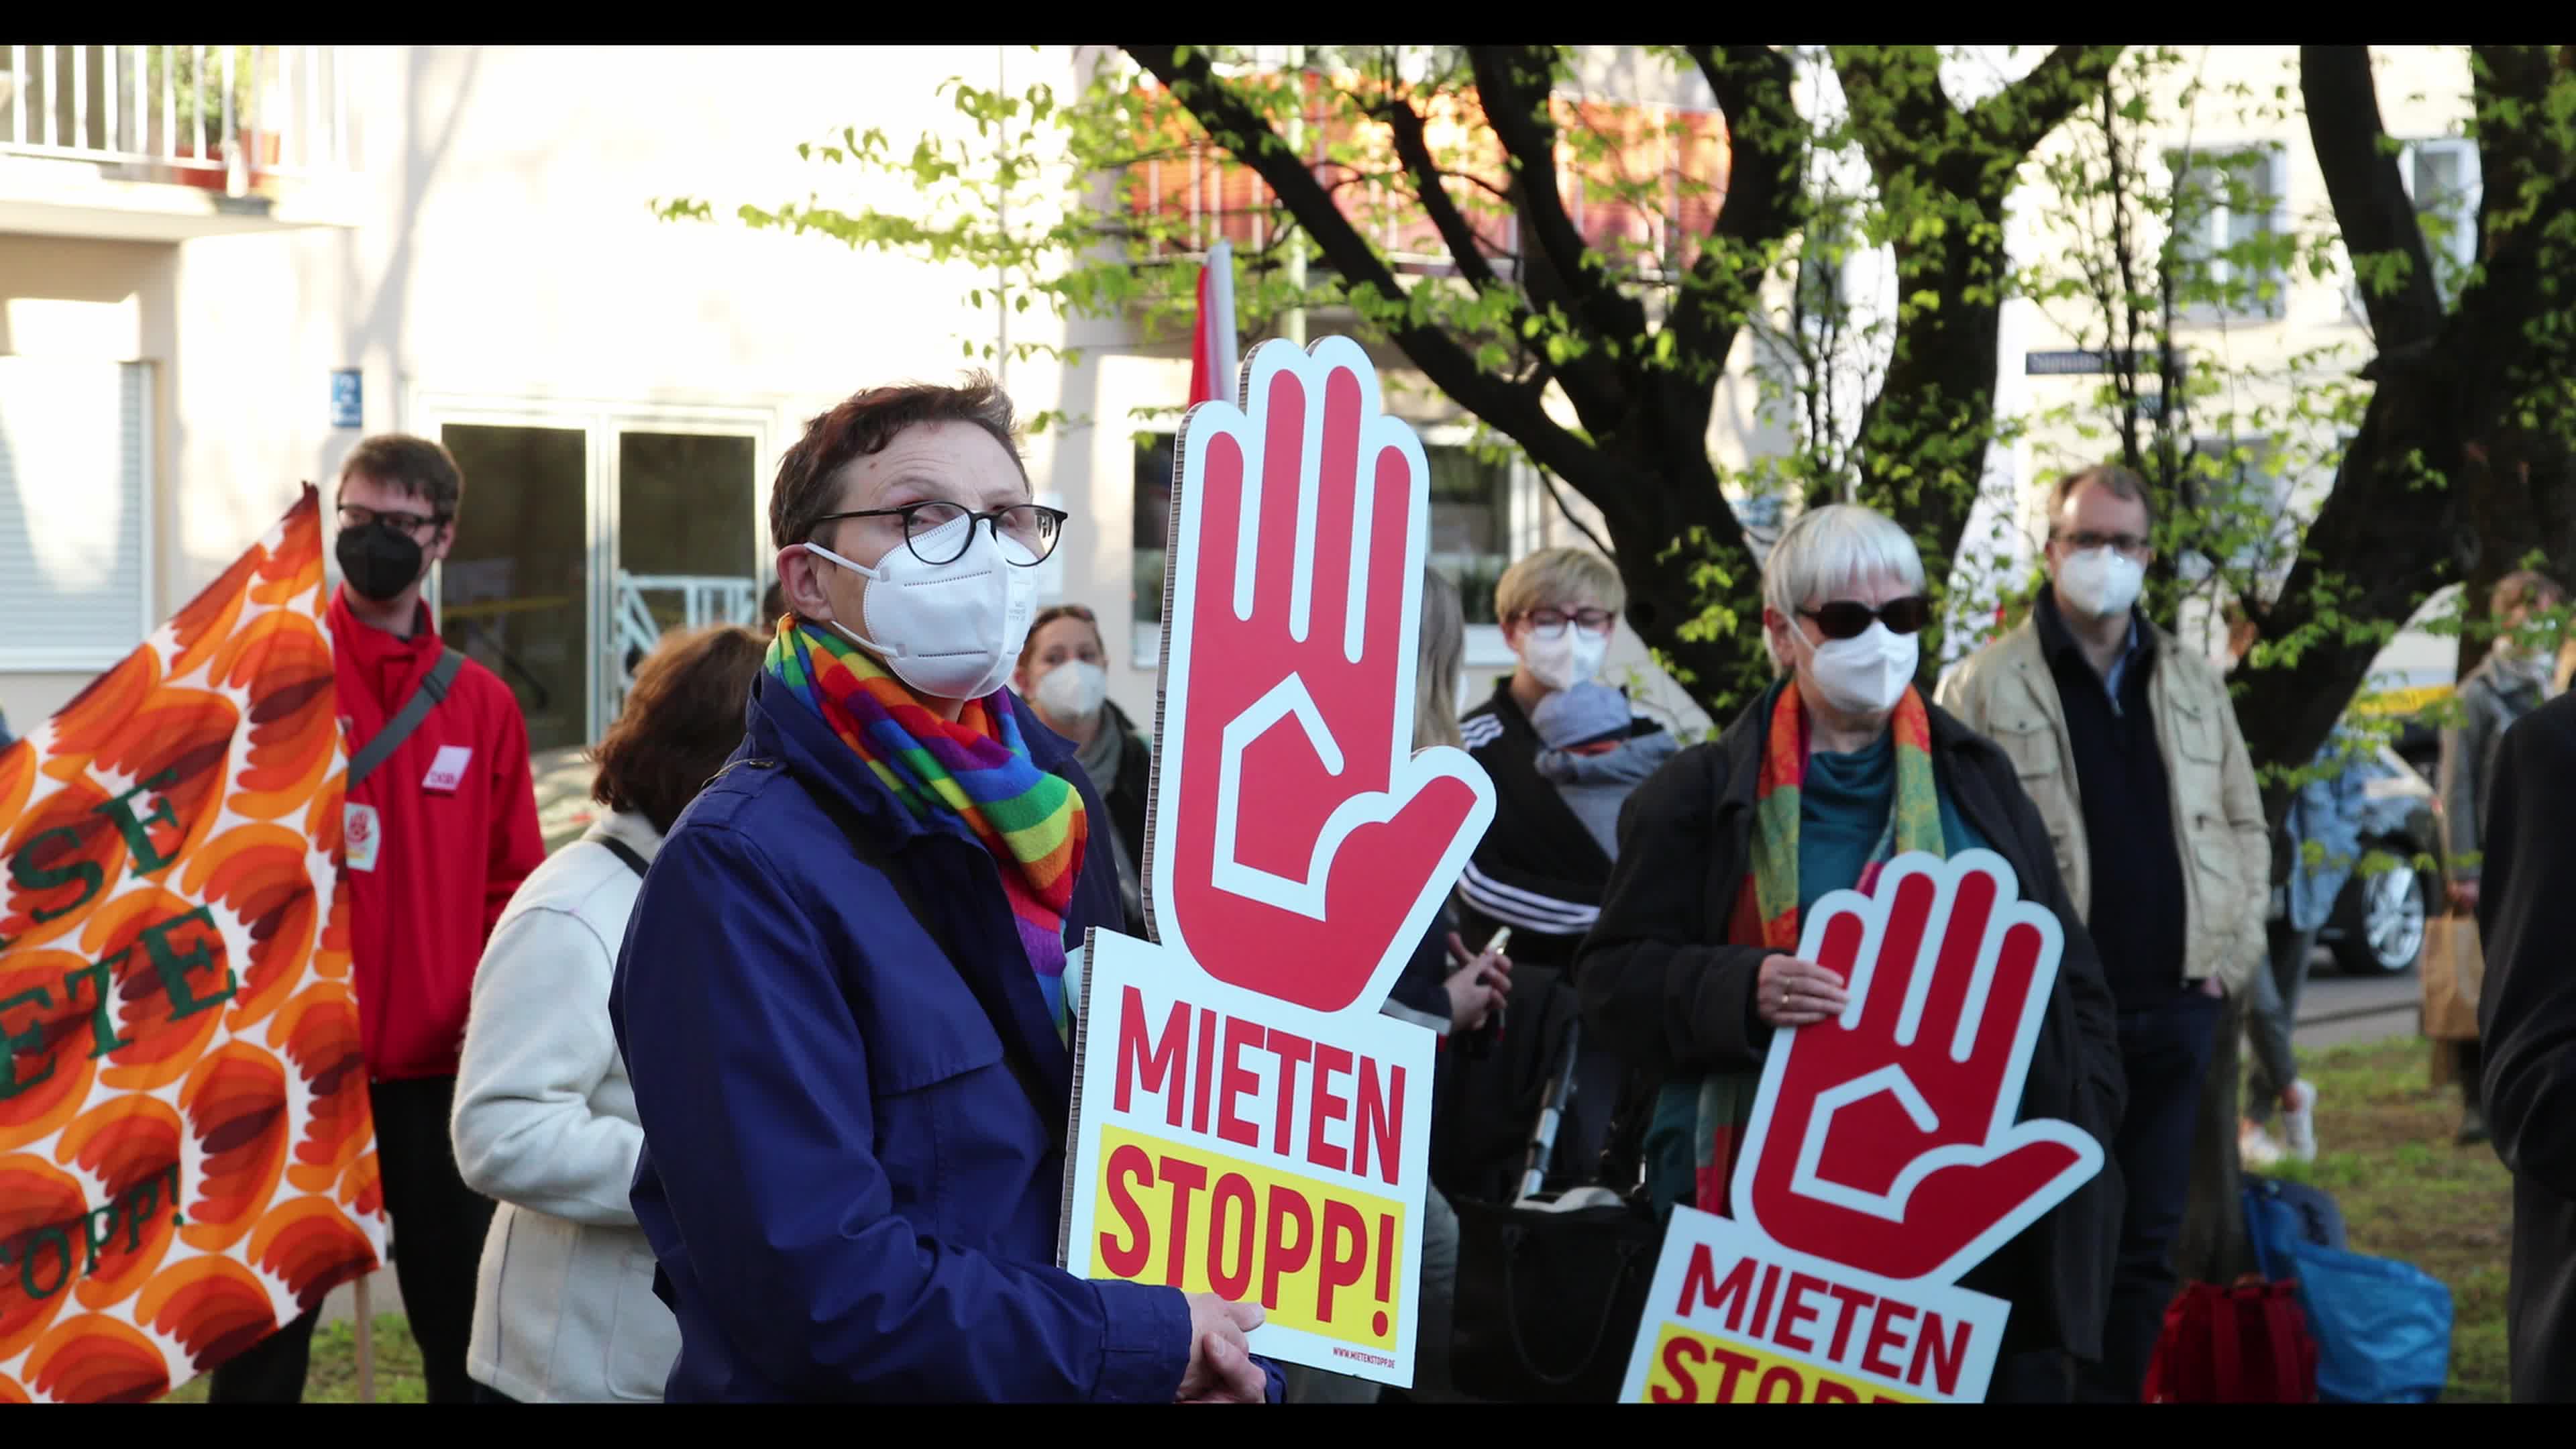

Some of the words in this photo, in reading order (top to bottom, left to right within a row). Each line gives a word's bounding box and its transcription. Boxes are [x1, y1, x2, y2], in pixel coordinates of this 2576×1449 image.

[1114, 984, 1406, 1186] MIETEN
[1099, 1144, 1395, 1338] STOPP!
[1676, 1242, 1973, 1396] MIETEN
